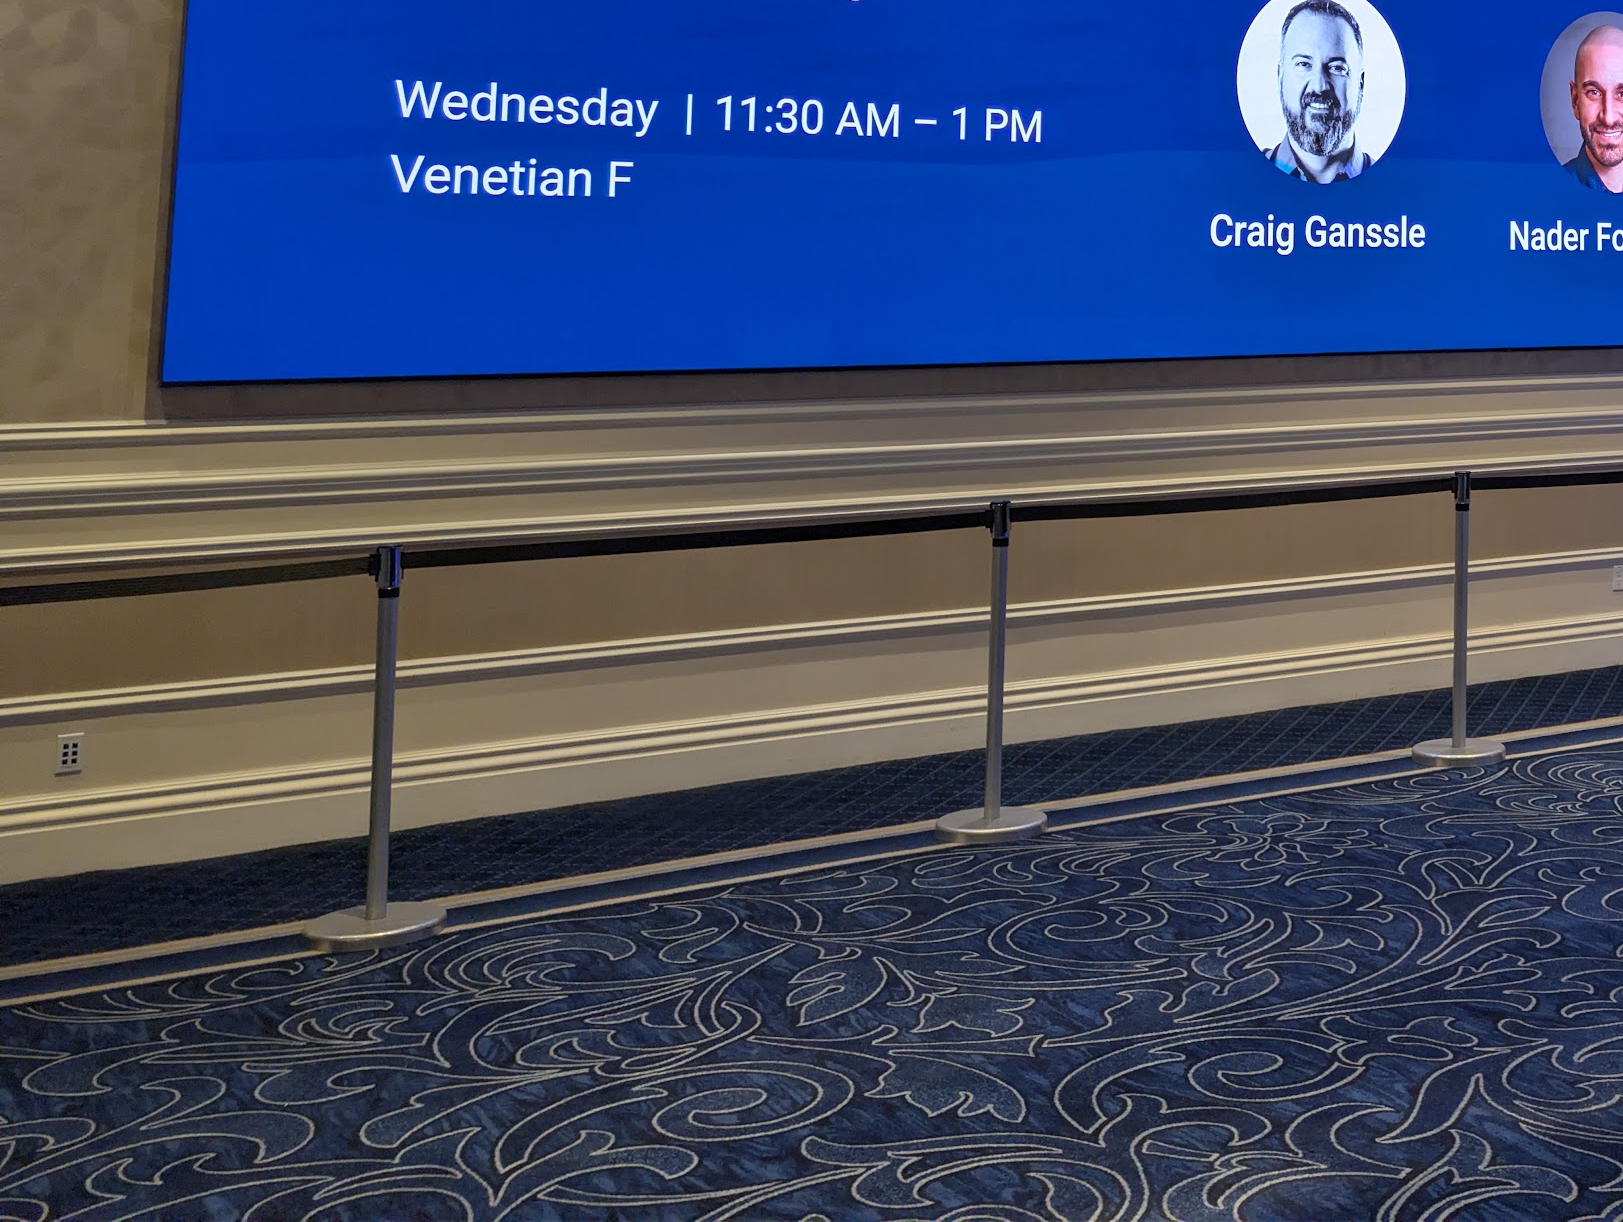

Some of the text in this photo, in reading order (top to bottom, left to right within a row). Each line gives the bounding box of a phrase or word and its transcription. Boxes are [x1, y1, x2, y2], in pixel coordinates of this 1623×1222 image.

[394, 79, 660, 138] Wednesday
[715, 95, 825, 135] 11:30
[833, 101, 901, 139] AM
[951, 106, 968, 141] 1
[984, 107, 1043, 144] PM
[390, 154, 635, 198] Venetian F
[1210, 213, 1427, 257] Craig Ganssle
[1509, 219, 1591, 253] Nader
